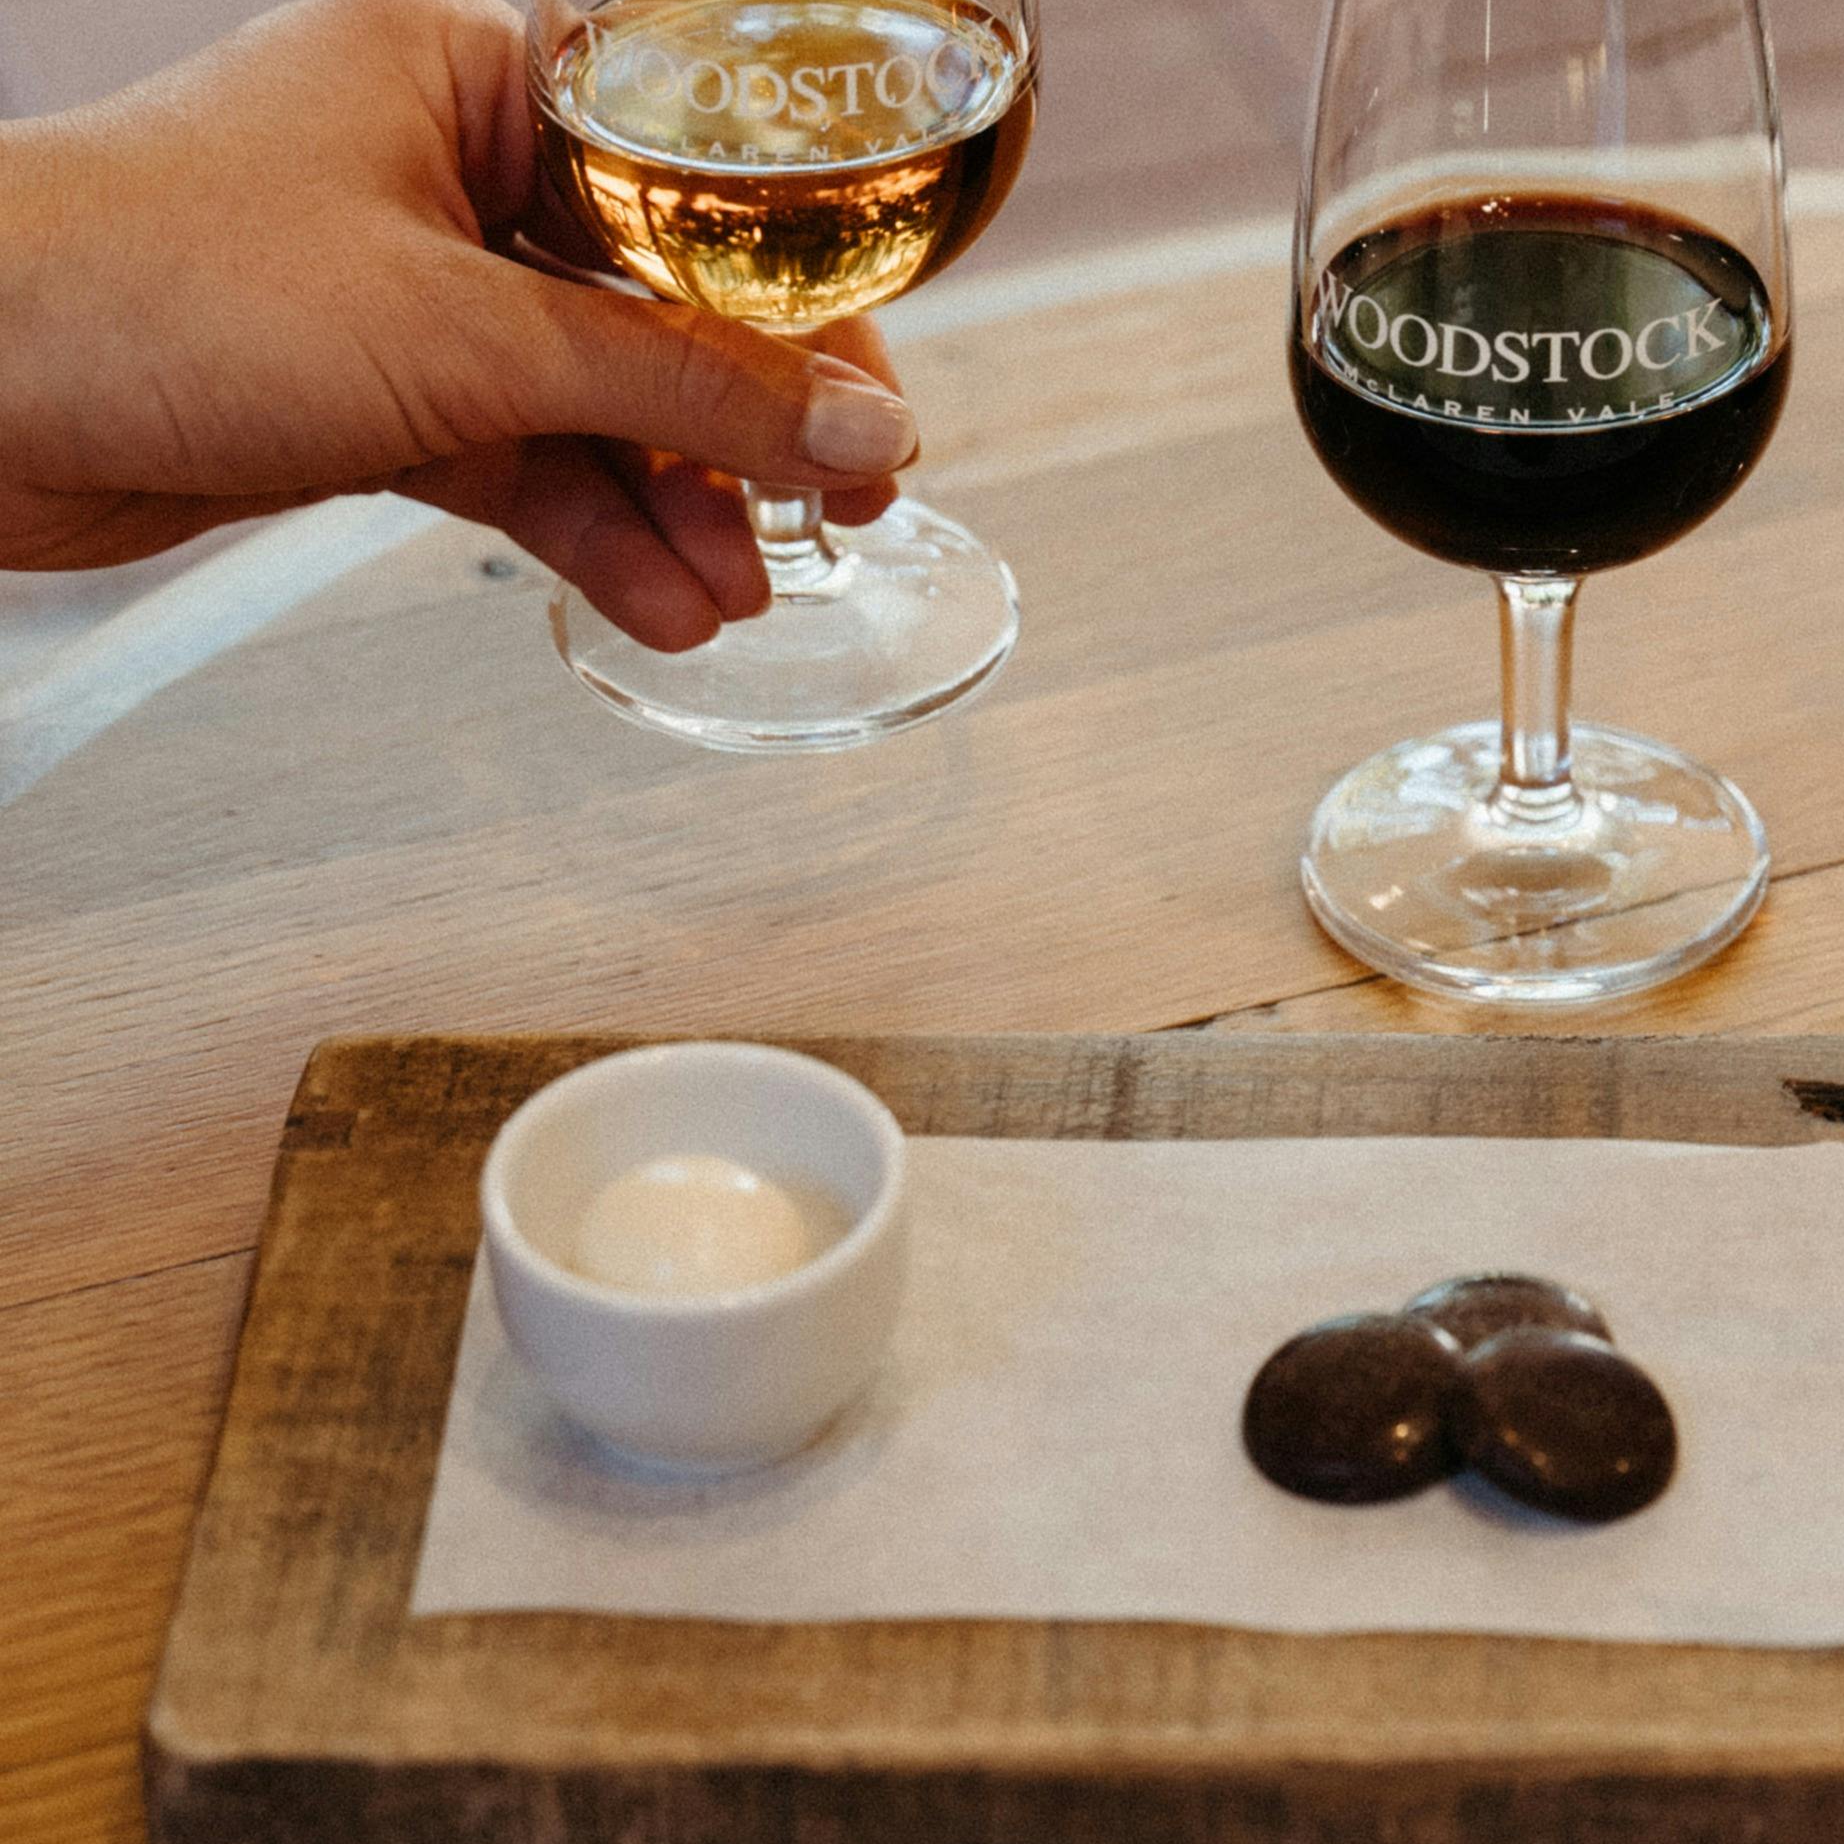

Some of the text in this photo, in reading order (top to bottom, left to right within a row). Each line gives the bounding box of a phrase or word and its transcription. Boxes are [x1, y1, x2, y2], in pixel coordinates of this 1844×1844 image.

[1318, 268, 1726, 383] WOODSTOCK
[1341, 365, 1675, 424] McLAREN VALE
